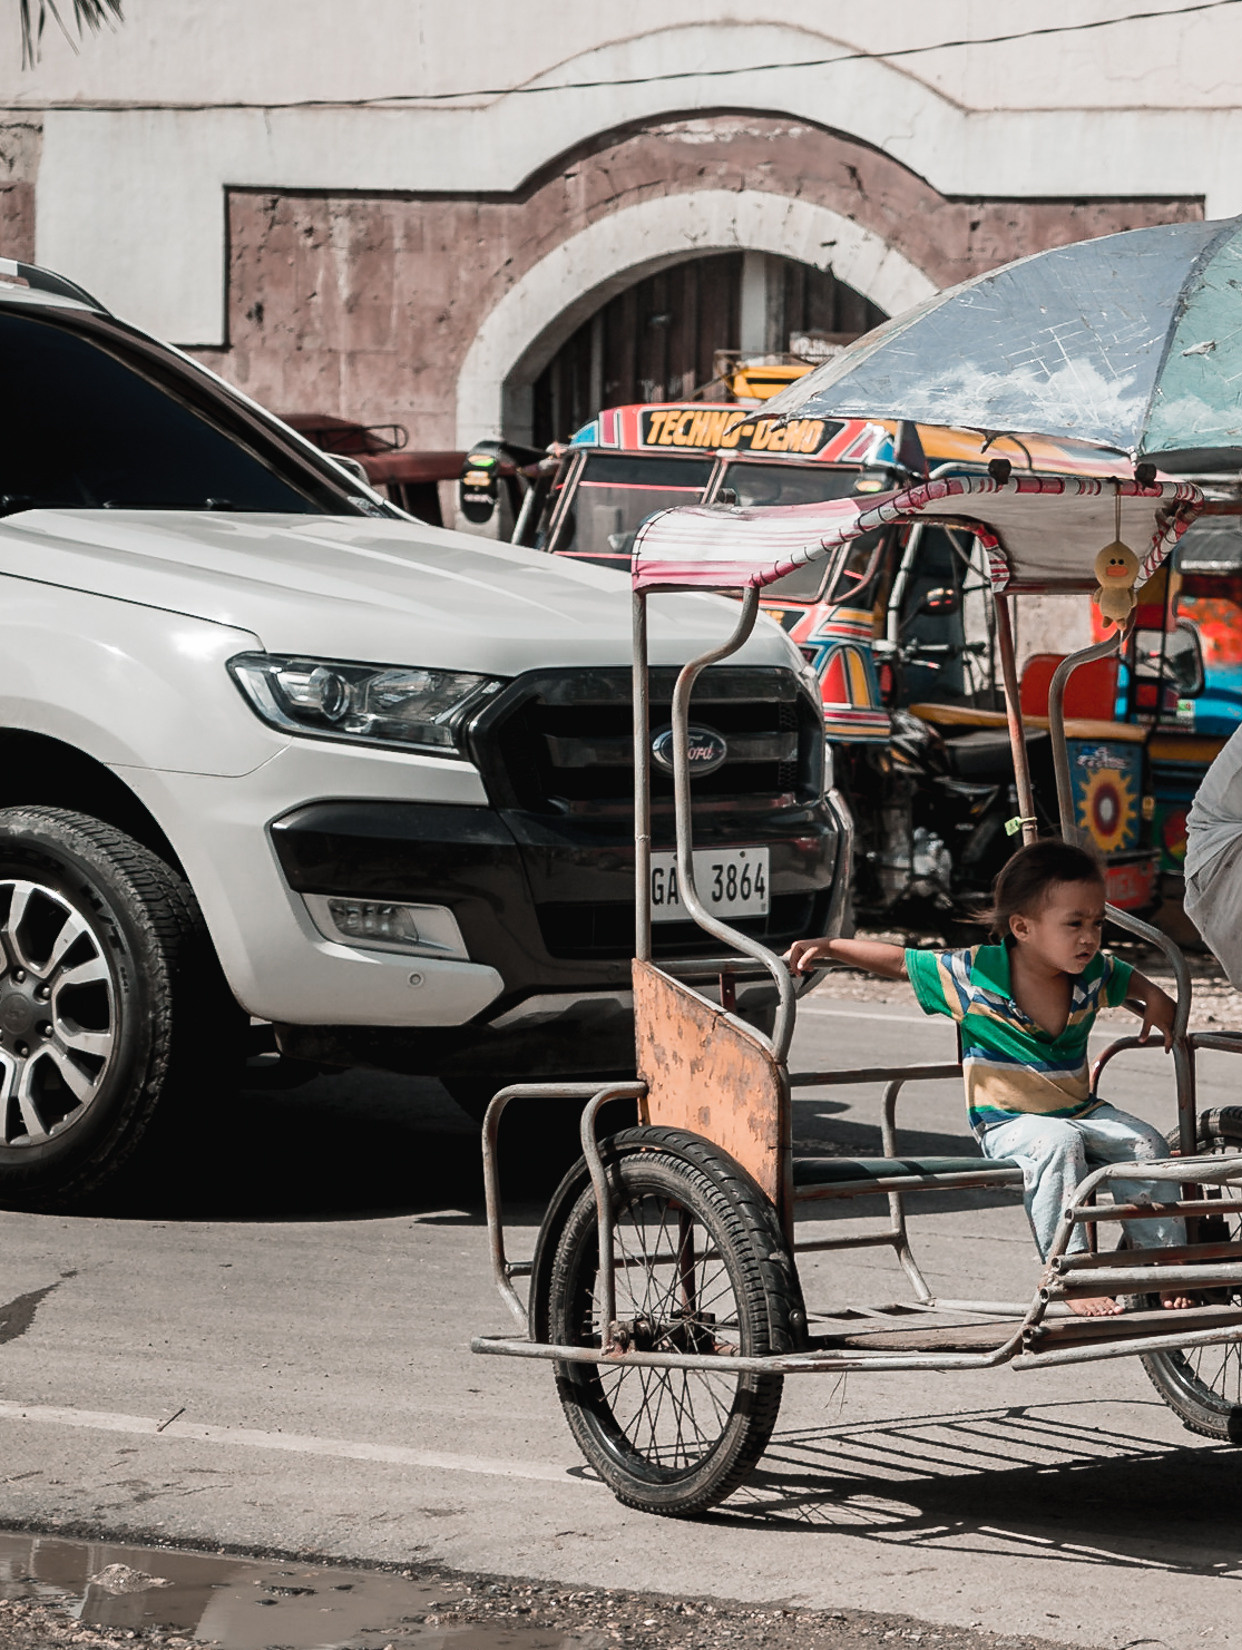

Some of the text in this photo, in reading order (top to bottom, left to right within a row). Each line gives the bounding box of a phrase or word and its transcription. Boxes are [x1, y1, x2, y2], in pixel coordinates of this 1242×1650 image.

[647, 409, 825, 453] TECHNO-DEMO
[688, 738, 715, 761] ord
[651, 862, 766, 906] GA 3864
